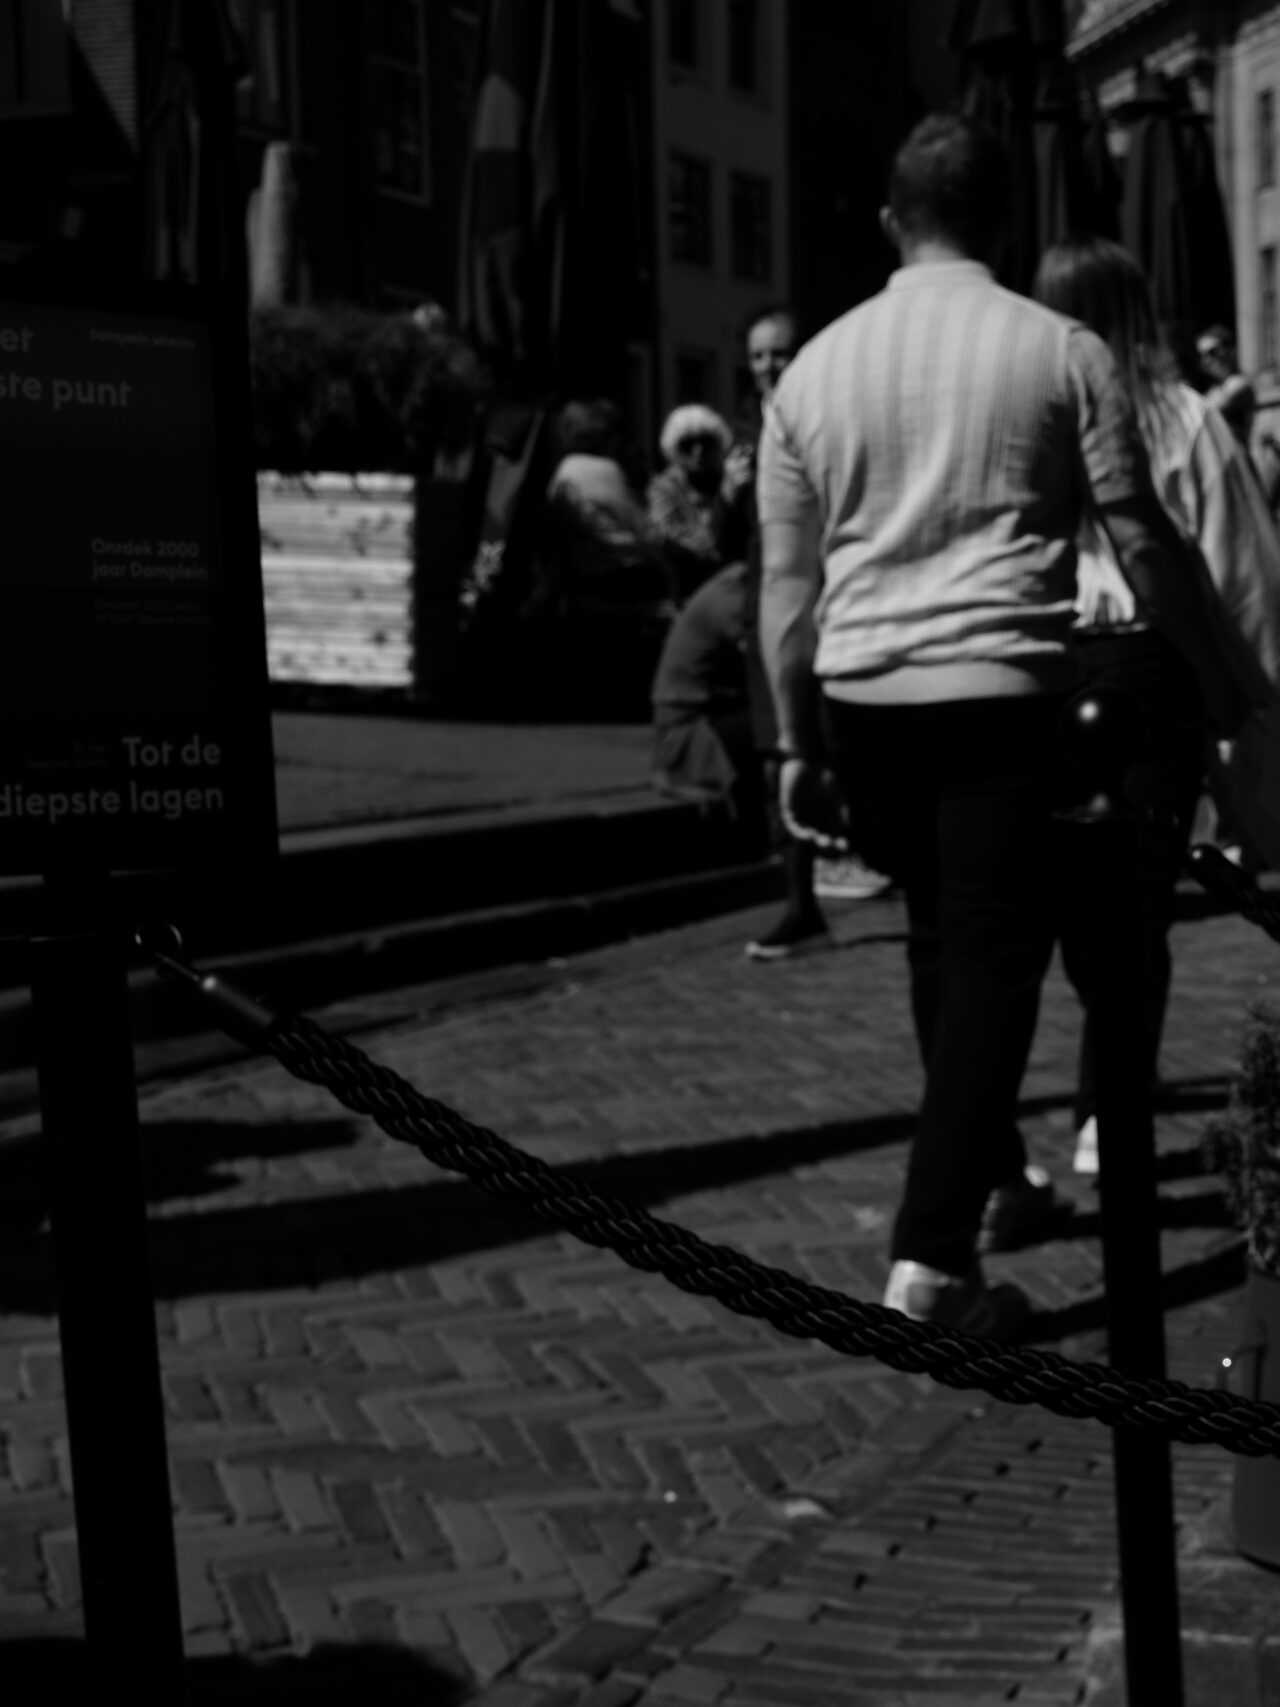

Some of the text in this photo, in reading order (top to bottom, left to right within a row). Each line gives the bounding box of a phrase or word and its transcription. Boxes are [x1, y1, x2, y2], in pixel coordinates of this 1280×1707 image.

[52, 378, 132, 411] punt
[91, 537, 200, 558] Ontdek 2000
[91, 560, 209, 582] jaar Domplein
[121, 734, 174, 767] Tot
[180, 733, 222, 766] de
[0, 779, 225, 825] diepste lagen
